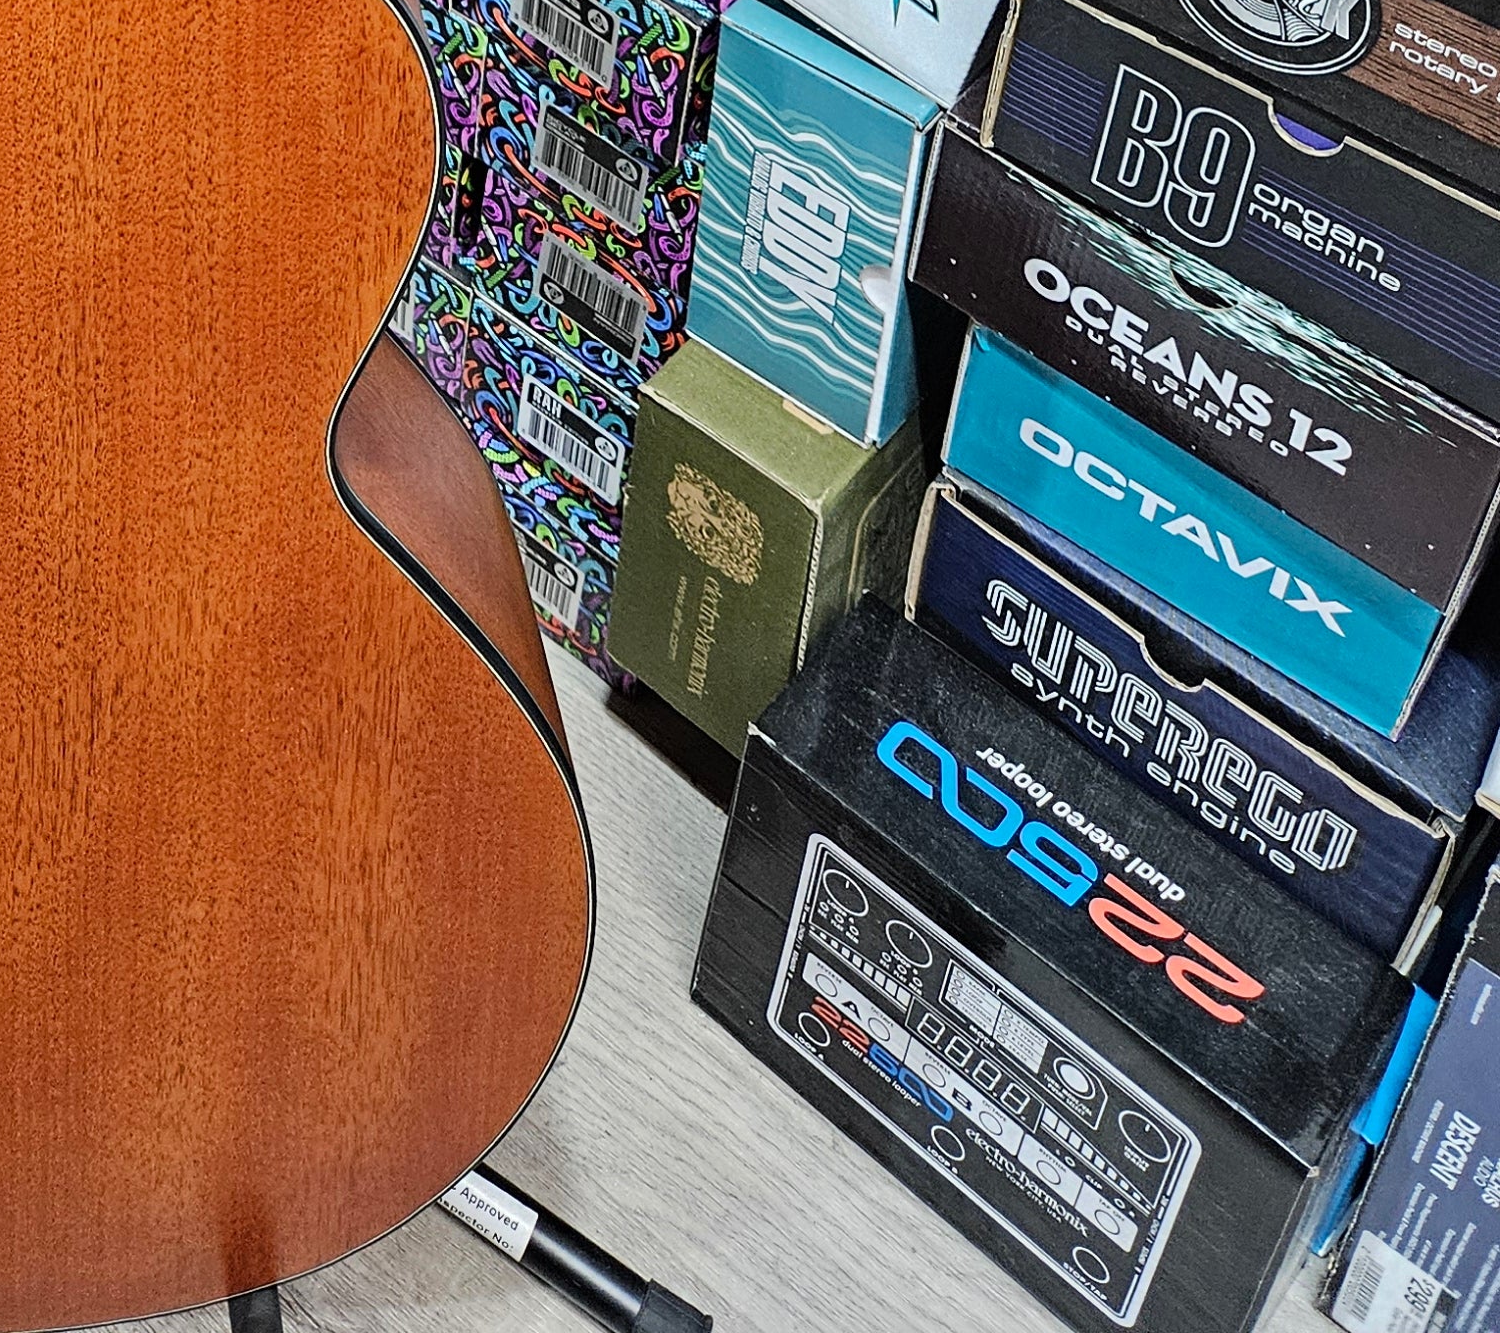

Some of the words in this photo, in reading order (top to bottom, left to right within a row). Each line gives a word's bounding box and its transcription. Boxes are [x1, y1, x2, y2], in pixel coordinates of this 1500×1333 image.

[1387, 39, 1488, 96] rotary
[1393, 21, 1497, 77] stereo
[1091, 63, 1256, 248] B9
[759, 160, 852, 326] EDDY
[1247, 202, 1401, 292] machine
[1249, 181, 1386, 264] organ
[532, 387, 562, 419] RAH
[1023, 255, 1290, 429] OCEANS
[1287, 406, 1356, 478] 12
[1065, 315, 1144, 371] DUAL
[1162, 375, 1289, 457] STEREO
[1110, 354, 1233, 437] REVERB
[1018, 415, 1354, 639] OCTAVIX
[979, 575, 1359, 876] SUPEREGO
[975, 746, 1054, 808] looper
[1009, 660, 1132, 760] synth
[1144, 759, 1298, 876] engine
[1051, 799, 1130, 861] stereo
[1124, 854, 1186, 903] dual
[794, 1032, 817, 1056] LOOP
[841, 999, 863, 1020] A
[842, 1038, 865, 1059] dual
[862, 1052, 892, 1083] stereo
[890, 1079, 922, 1109] looper
[927, 1145, 951, 1168] LOOP
[965, 1127, 1090, 1238] electro-harmonix
[1429, 1110, 1482, 1191] DESCENT
[438, 1197, 491, 1237] nspector
[459, 1186, 519, 1232] Approved
